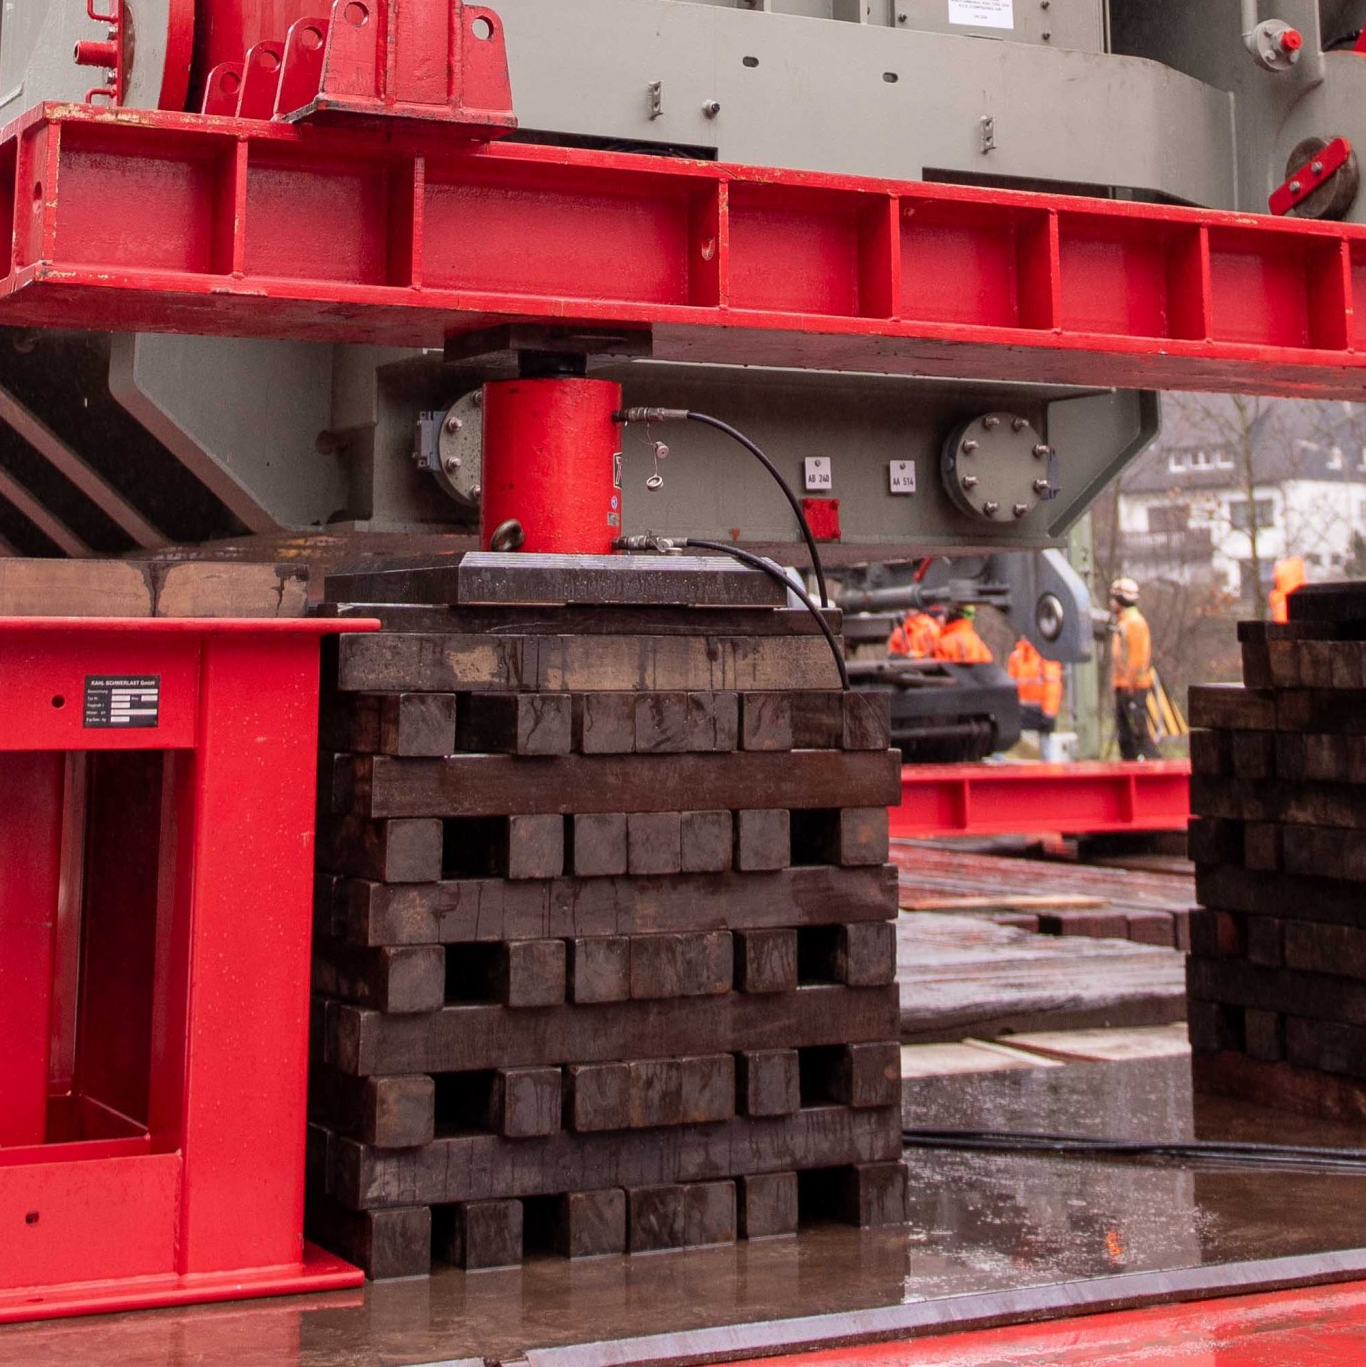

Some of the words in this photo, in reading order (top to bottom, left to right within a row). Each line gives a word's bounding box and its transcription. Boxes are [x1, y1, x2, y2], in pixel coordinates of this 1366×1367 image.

[808, 474, 817, 483] AB
[892, 477, 901, 486] AA
[903, 477, 914, 486] 514
